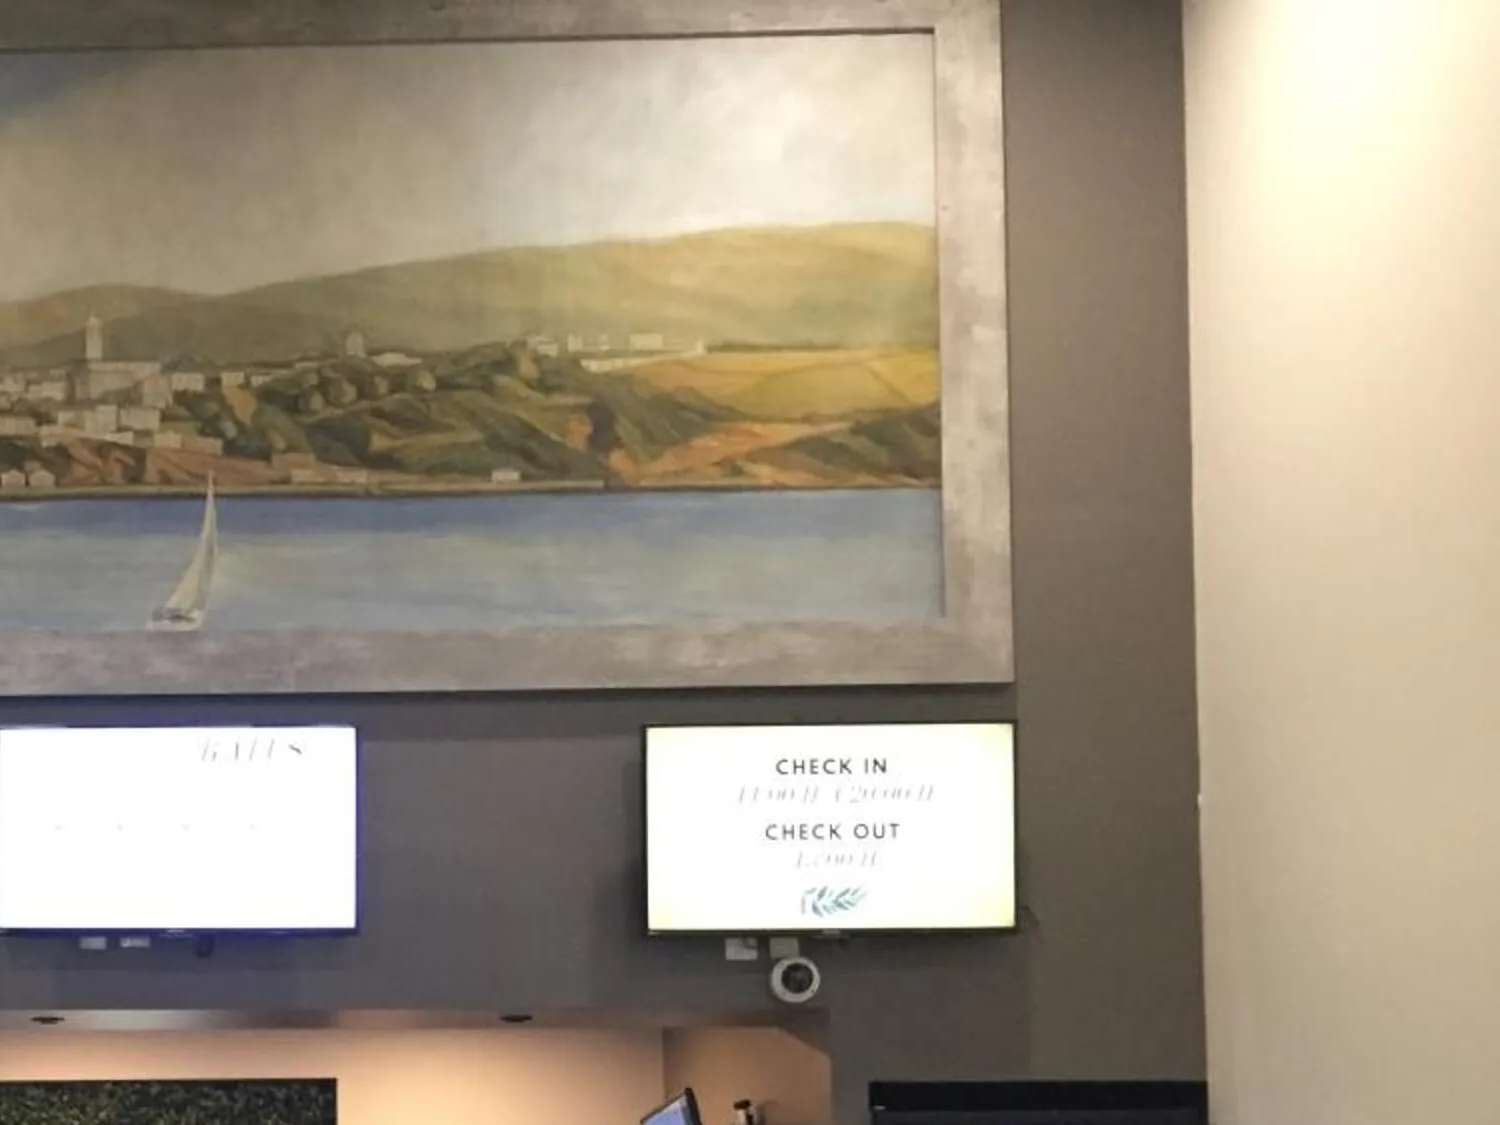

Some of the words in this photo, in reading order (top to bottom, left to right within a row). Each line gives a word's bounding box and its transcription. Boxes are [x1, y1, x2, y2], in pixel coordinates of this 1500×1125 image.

[774, 757, 854, 776] CHECK
[863, 756, 889, 775] IN
[763, 822, 843, 841] CHECK
[852, 821, 901, 841] OUT
